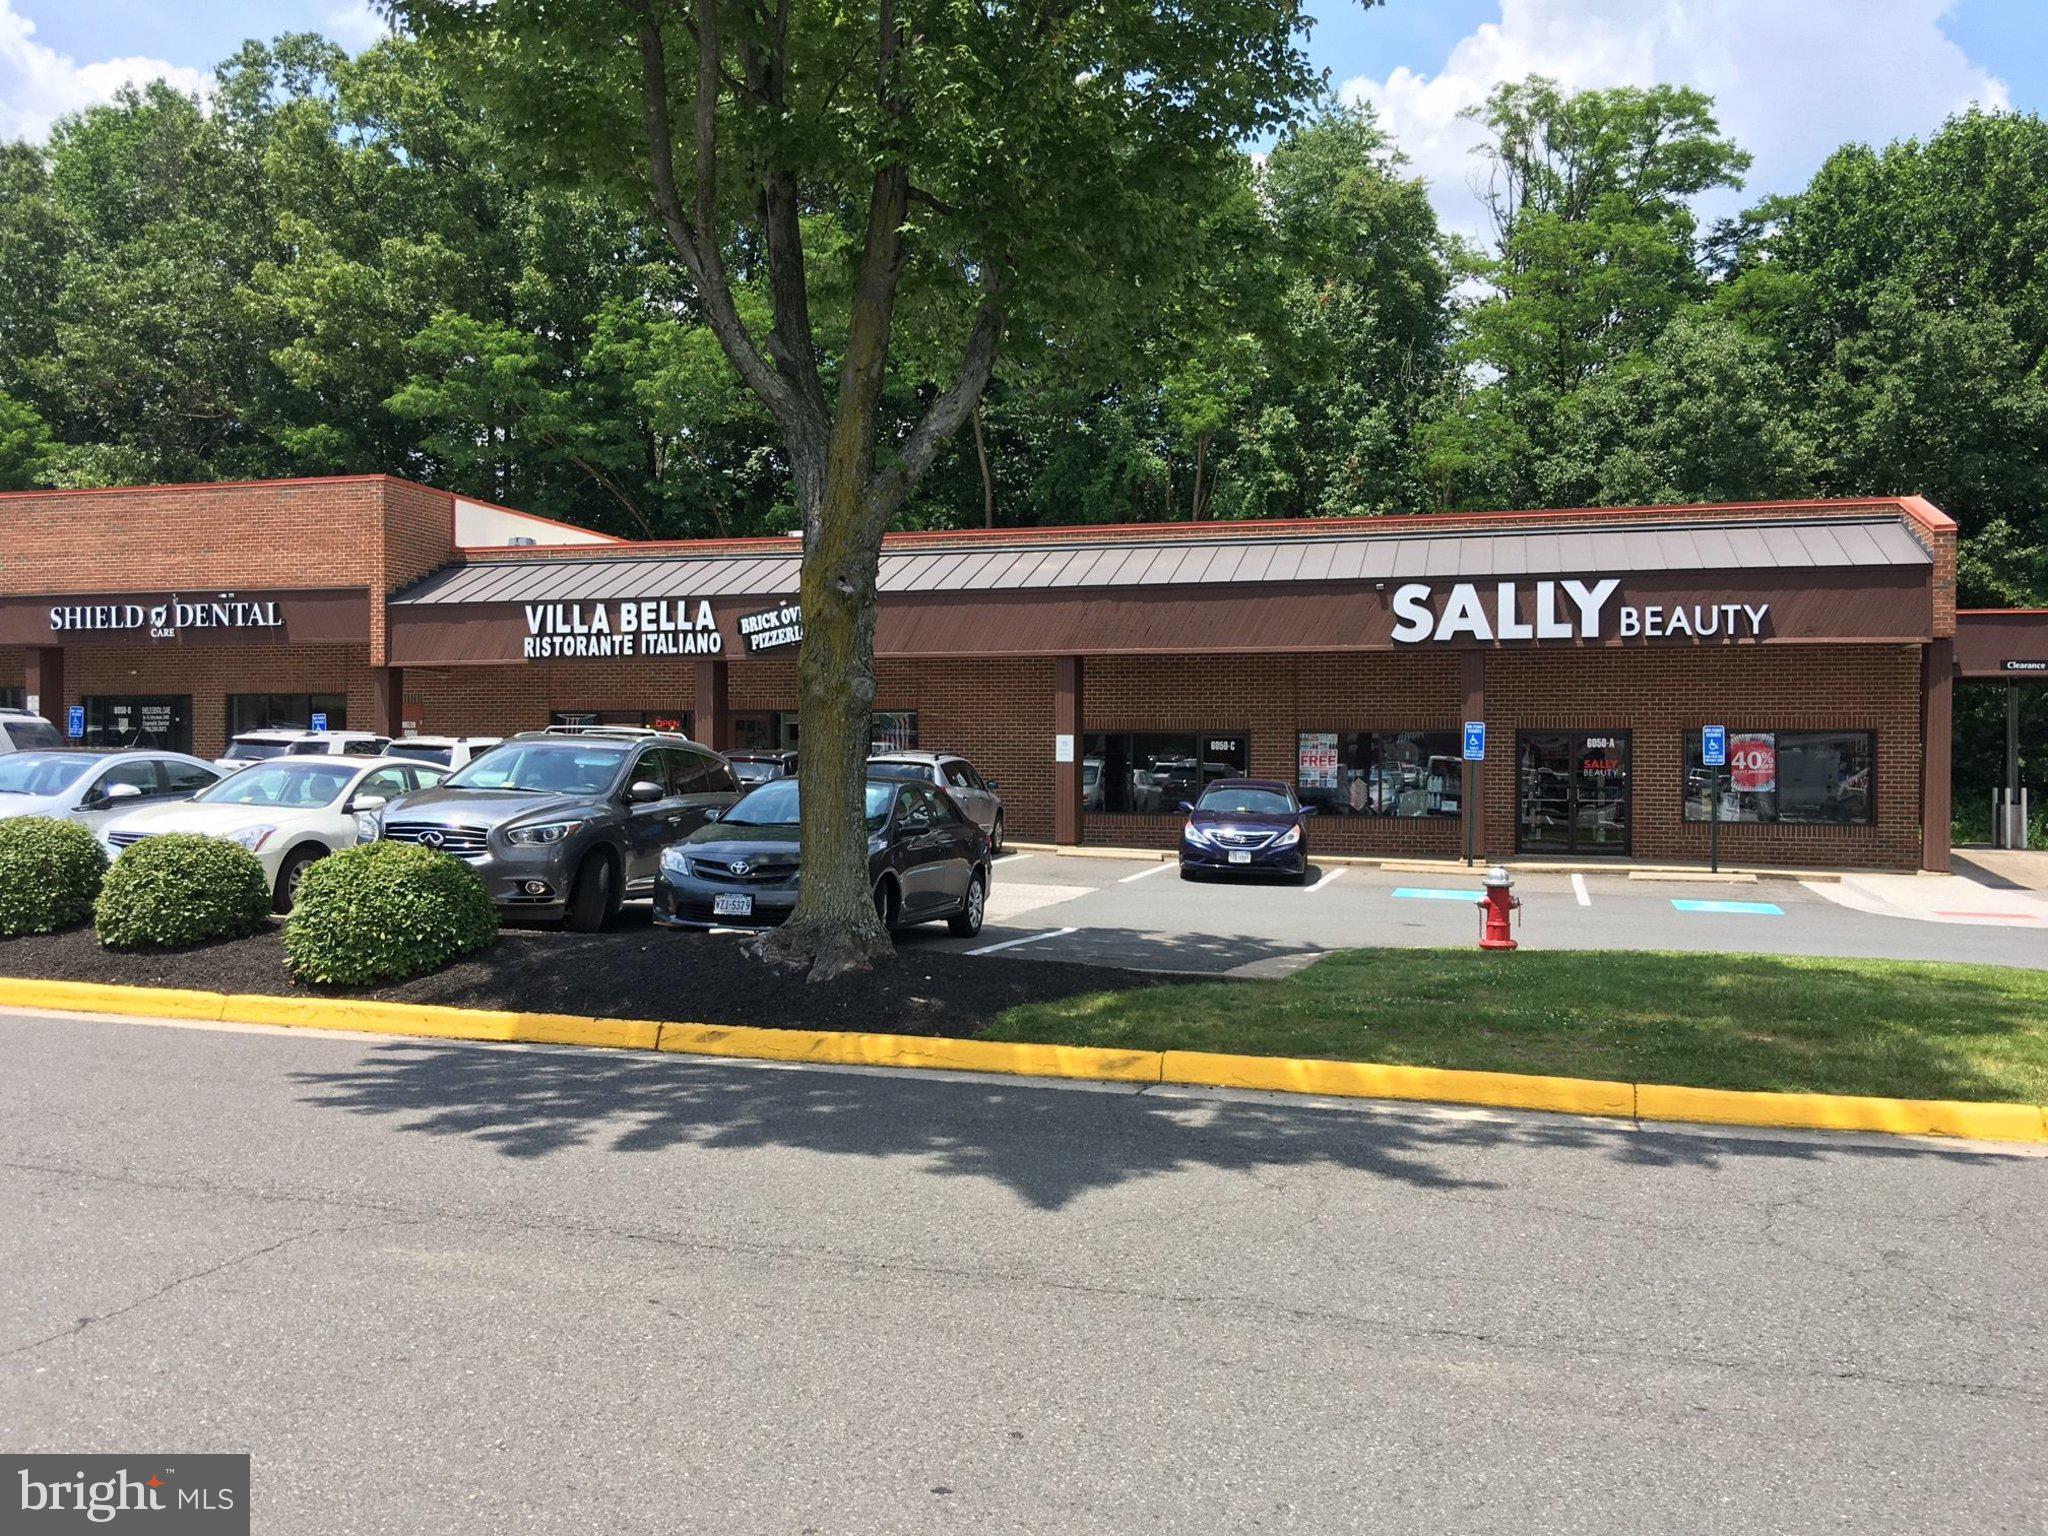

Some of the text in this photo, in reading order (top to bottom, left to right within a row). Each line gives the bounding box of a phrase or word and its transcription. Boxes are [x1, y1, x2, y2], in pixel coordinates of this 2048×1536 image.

[50, 602, 284, 630] SHIELD DENTAL
[525, 600, 715, 634] VILLA BELLA
[1391, 578, 1770, 643] SALLY BEAUTY
[741, 611, 780, 634] BRICK
[151, 628, 175, 637] CARE
[751, 625, 803, 650] PIZZERI
[524, 632, 721, 658] RISTORANTE ITALIANO
[2007, 661, 2046, 669] Clearance
[656, 719, 679, 728] OPEN
[1301, 755, 1336, 767] FREE
[1584, 759, 1618, 768] SALLY
[1583, 769, 1617, 777] BEAUTY
